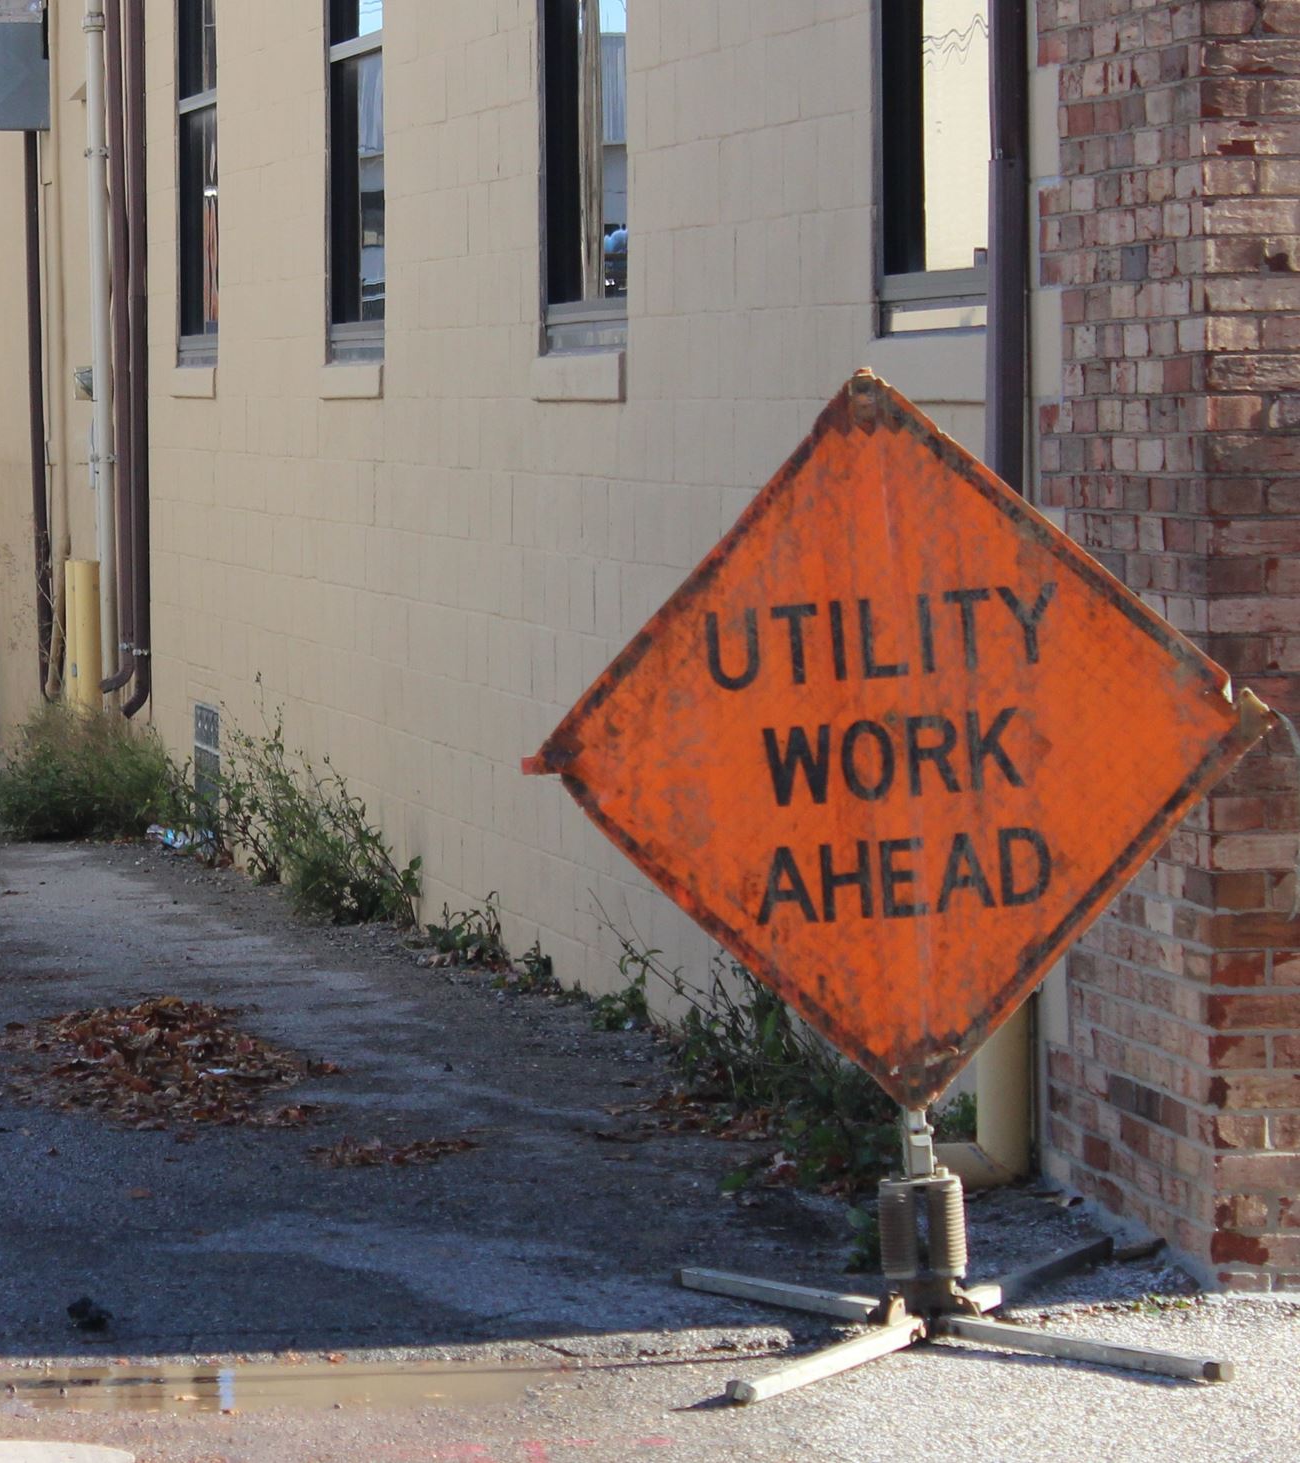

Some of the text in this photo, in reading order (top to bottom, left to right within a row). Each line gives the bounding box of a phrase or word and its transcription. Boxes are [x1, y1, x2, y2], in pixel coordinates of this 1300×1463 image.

[705, 582, 1058, 691] UTILITY
[762, 707, 1024, 807] WORK
[756, 826, 1052, 926] AHEAD
